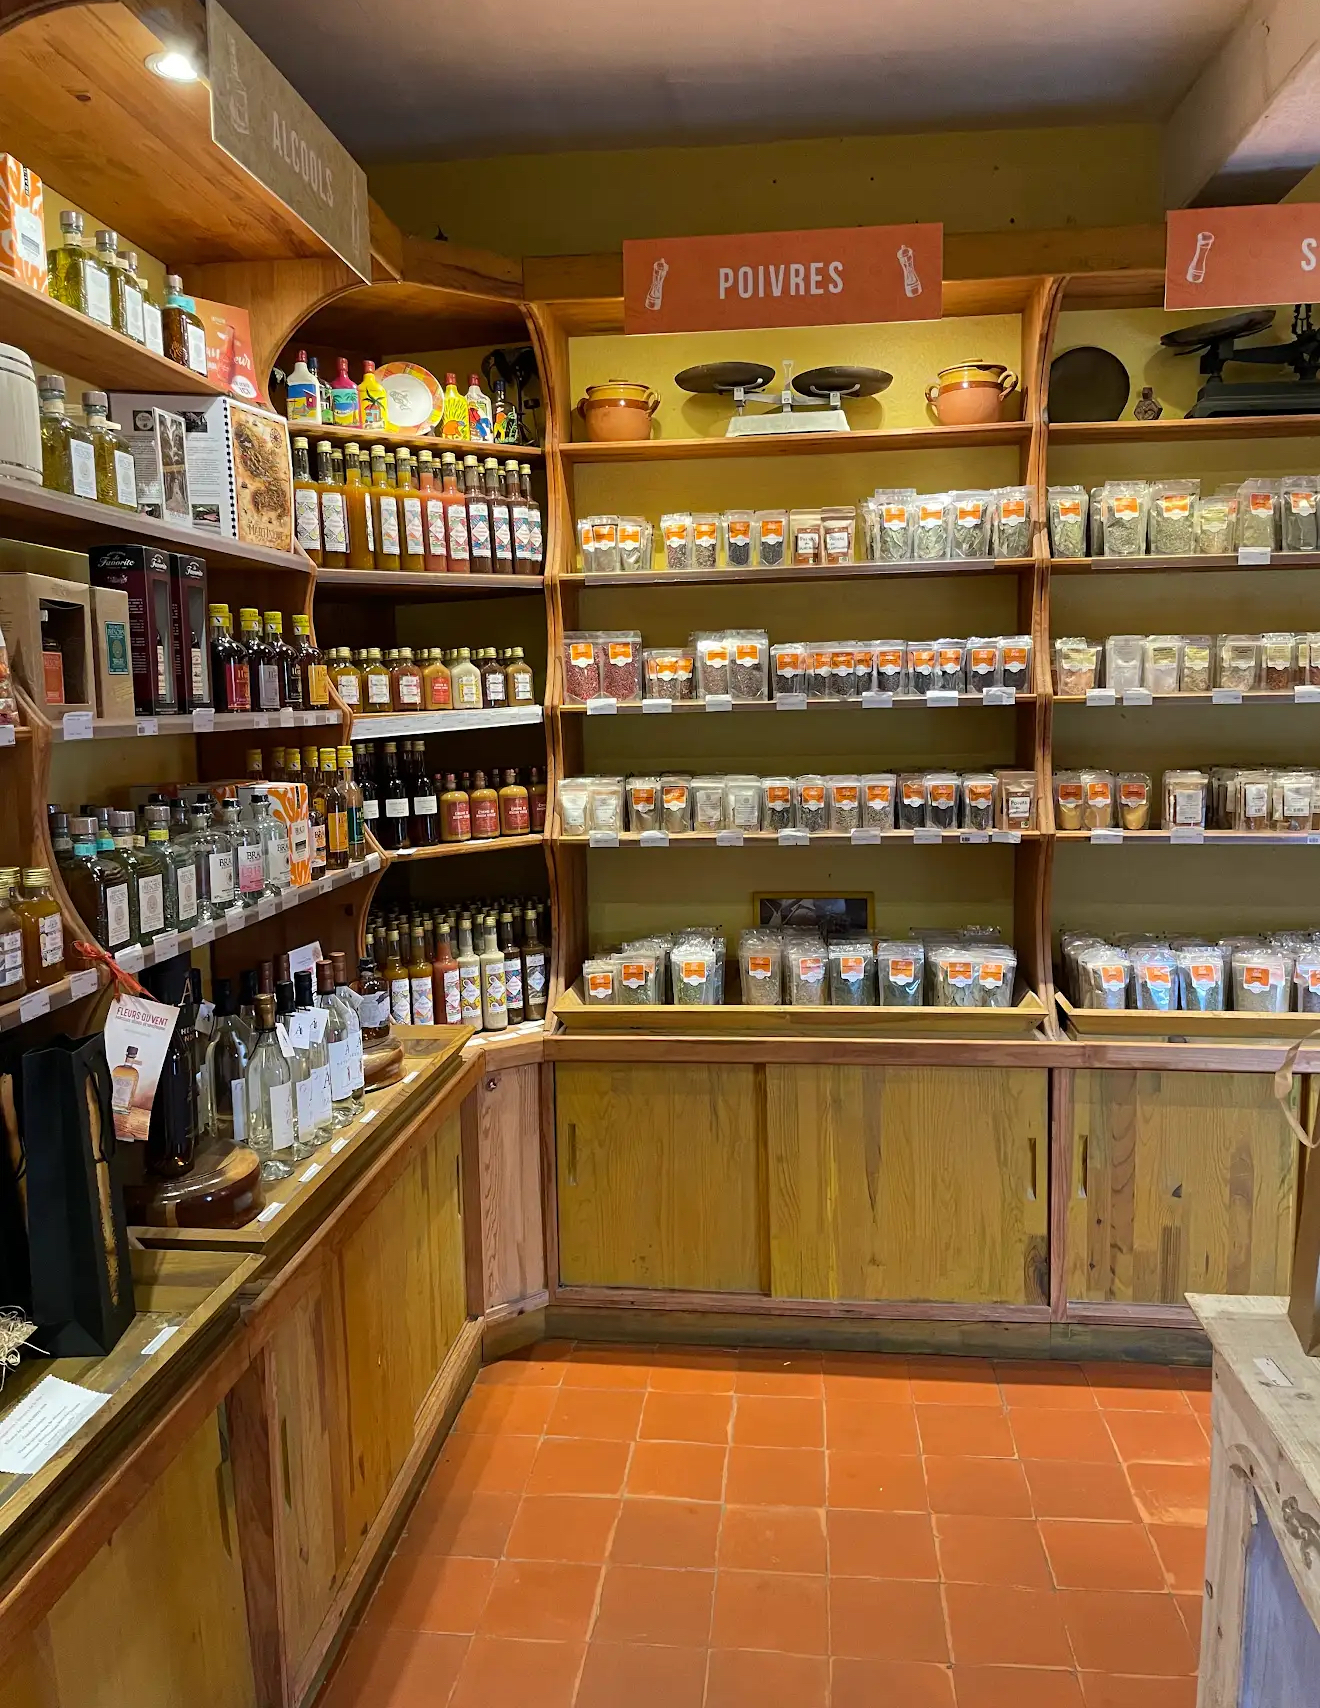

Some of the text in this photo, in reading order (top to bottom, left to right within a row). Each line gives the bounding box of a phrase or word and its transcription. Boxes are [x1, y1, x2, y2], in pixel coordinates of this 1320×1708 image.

[272, 111, 335, 208] ALCOOLS
[1301, 238, 1318, 271] S
[719, 261, 844, 300] POIVRES
[116, 1006, 142, 1021] FLEURS
[151, 1015, 169, 1027] VENT
